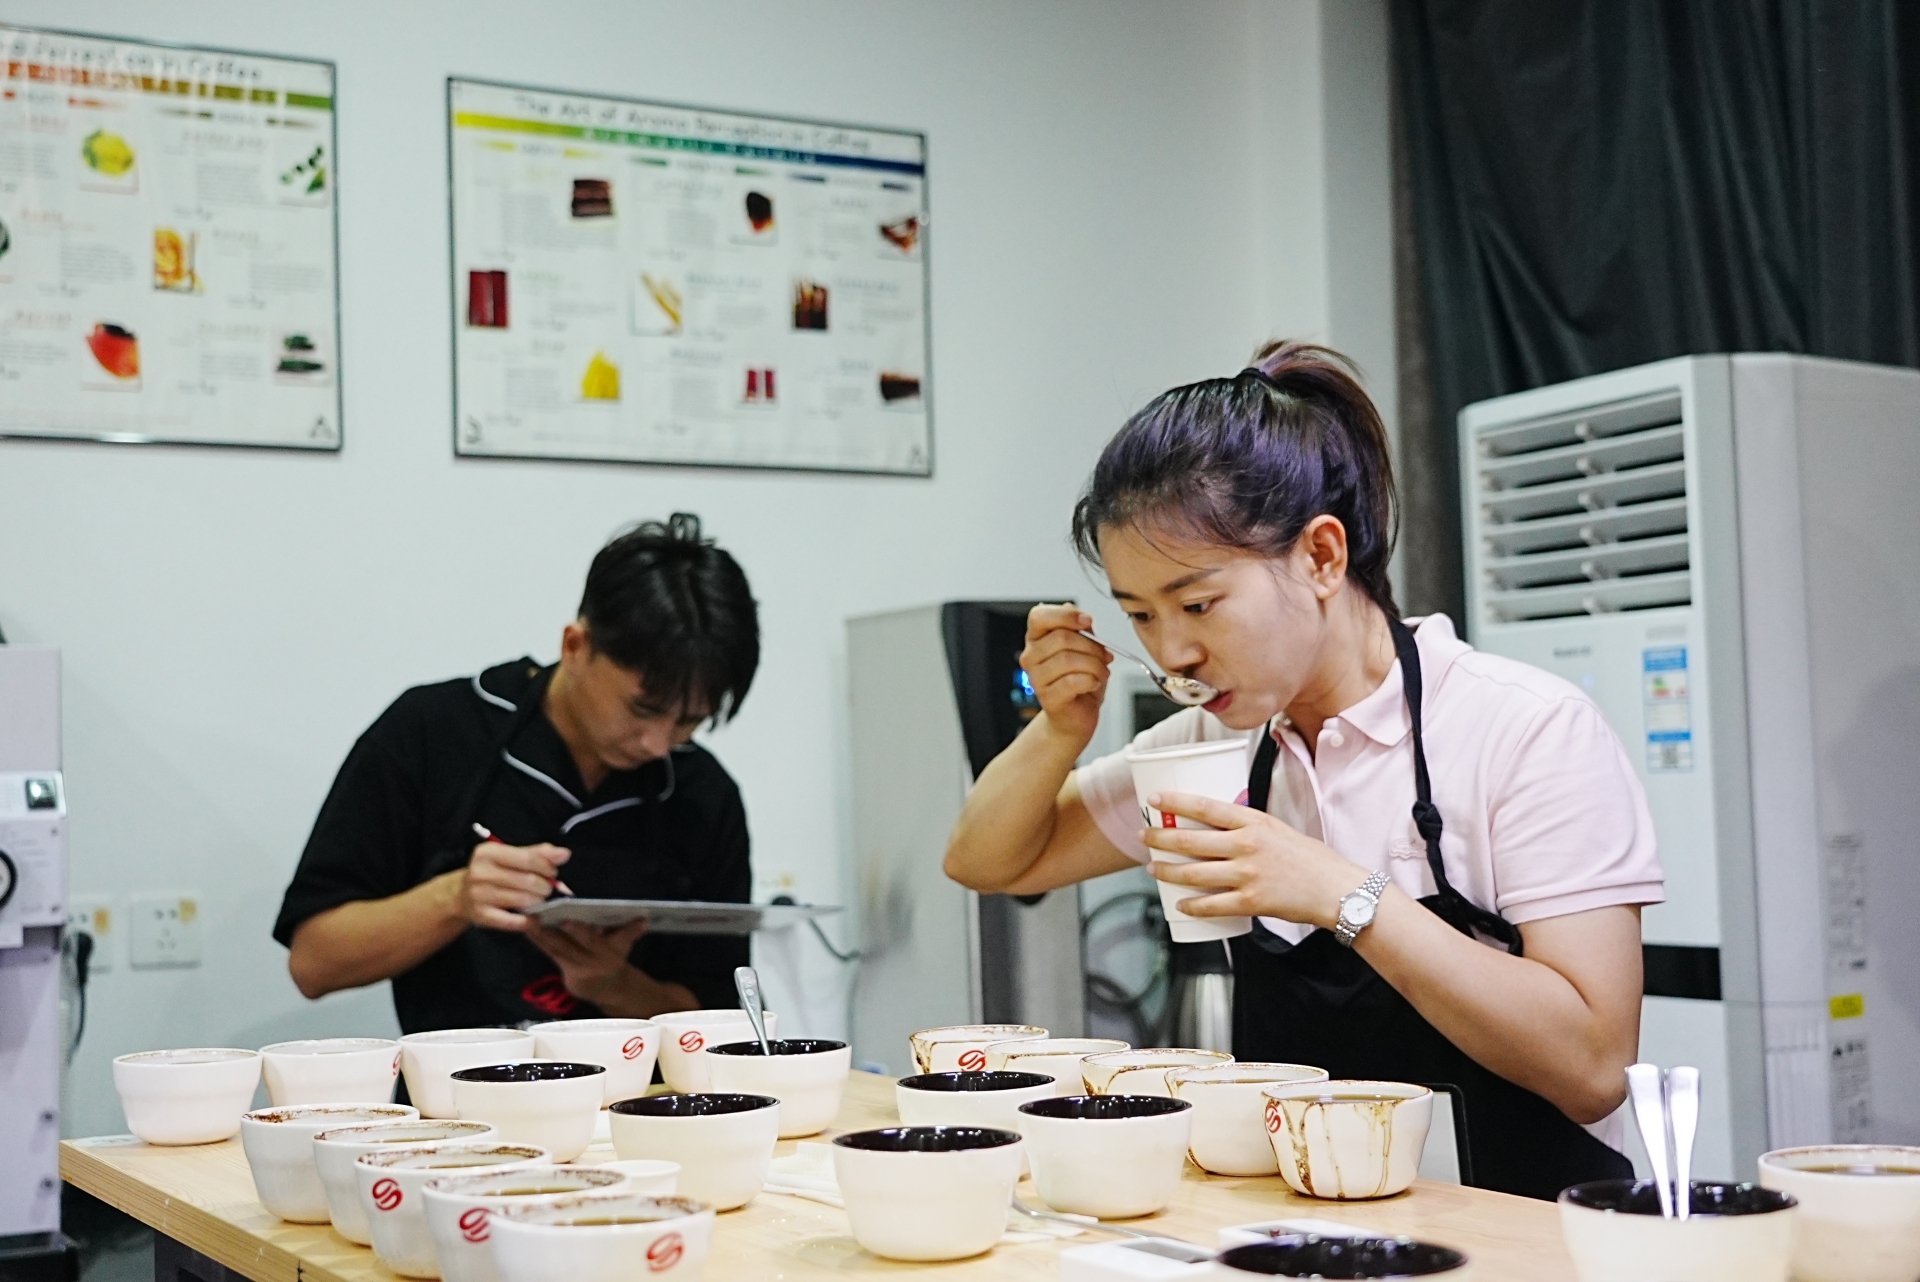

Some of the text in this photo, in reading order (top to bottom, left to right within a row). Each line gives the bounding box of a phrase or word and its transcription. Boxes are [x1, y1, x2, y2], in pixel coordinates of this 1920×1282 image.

[35, 39, 154, 69] Percepton
[188, 55, 263, 79] Coffee
[514, 95, 548, 114] The
[560, 102, 591, 118] Art
[601, 106, 618, 121] of
[628, 109, 687, 127] Aroma
[813, 130, 869, 149] Coffee
